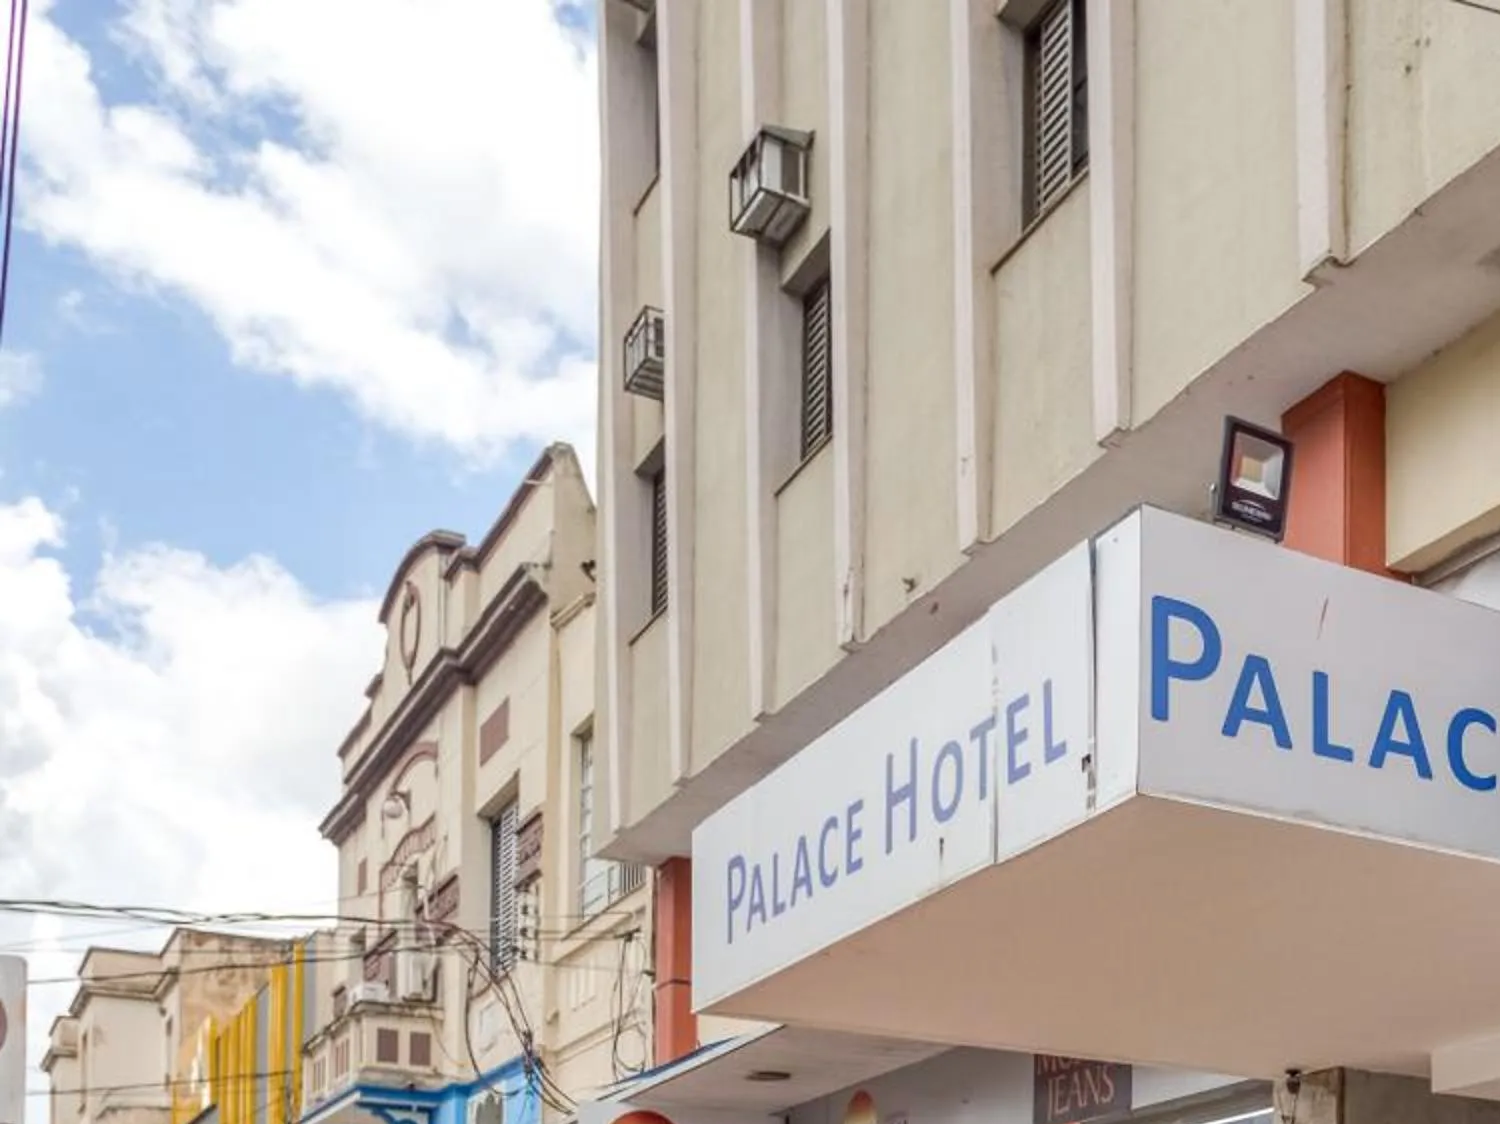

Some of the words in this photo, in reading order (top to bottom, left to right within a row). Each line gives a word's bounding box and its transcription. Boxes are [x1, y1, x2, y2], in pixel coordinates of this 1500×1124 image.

[727, 799, 865, 945] PALACE
[884, 678, 1068, 855] HOTEL
[1046, 1063, 1116, 1122] JEANS
